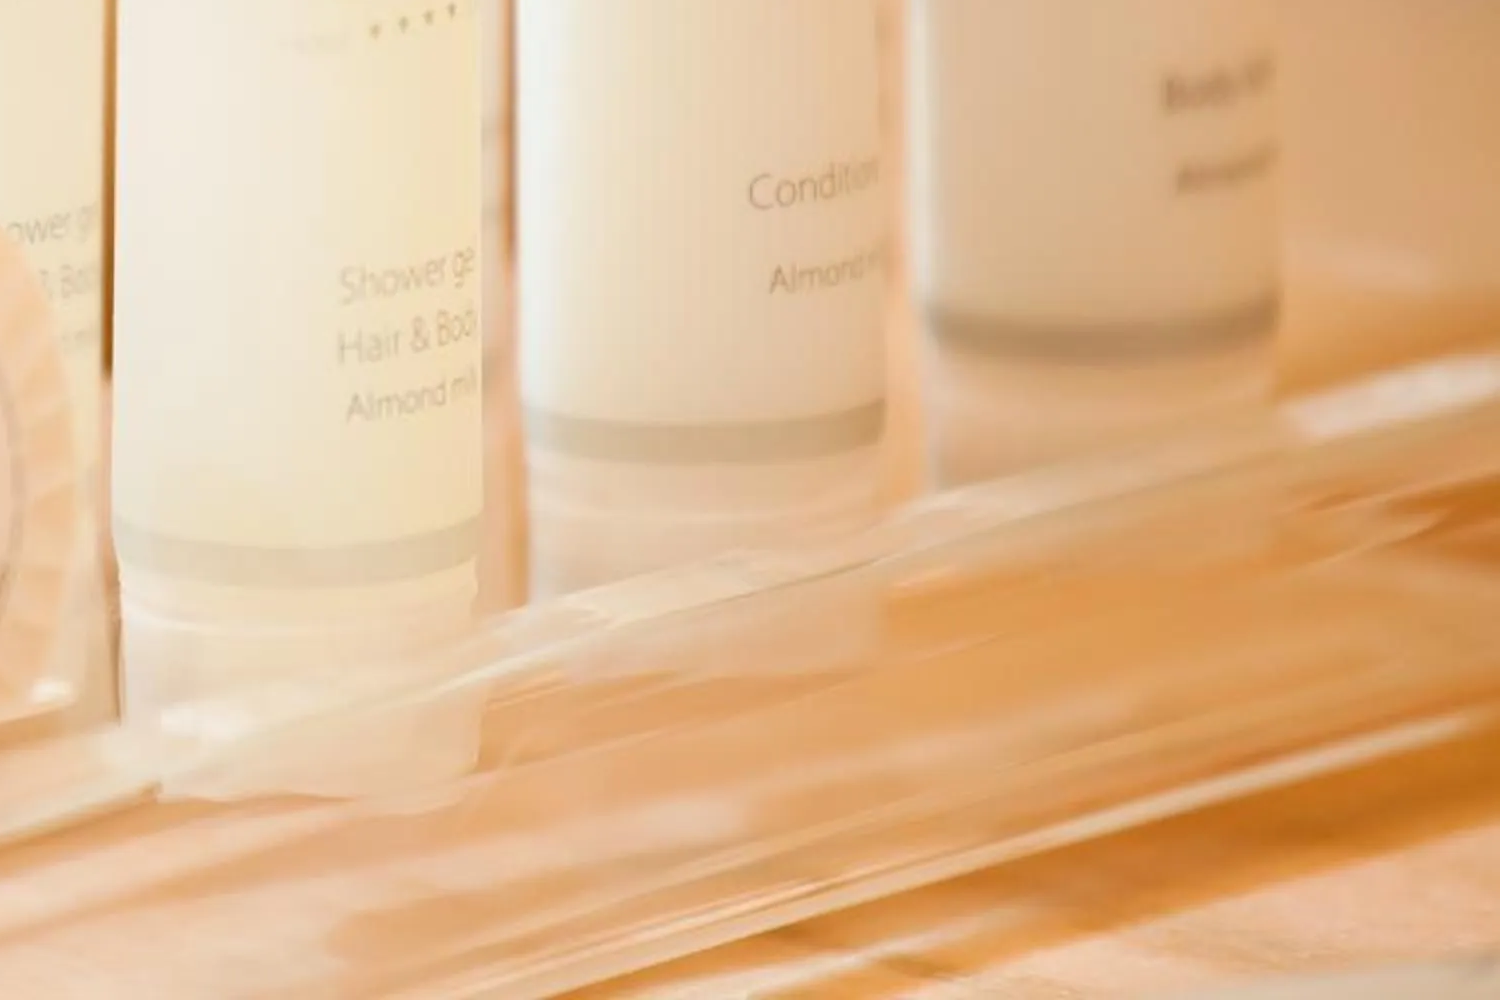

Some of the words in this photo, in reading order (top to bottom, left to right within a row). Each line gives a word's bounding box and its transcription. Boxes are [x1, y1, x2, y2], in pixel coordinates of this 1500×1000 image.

[7, 212, 71, 244] ower
[339, 256, 446, 305] Shower
[452, 246, 475, 288] ge
[337, 325, 401, 365] Hair
[410, 316, 430, 353] &
[346, 374, 446, 424] Almond
